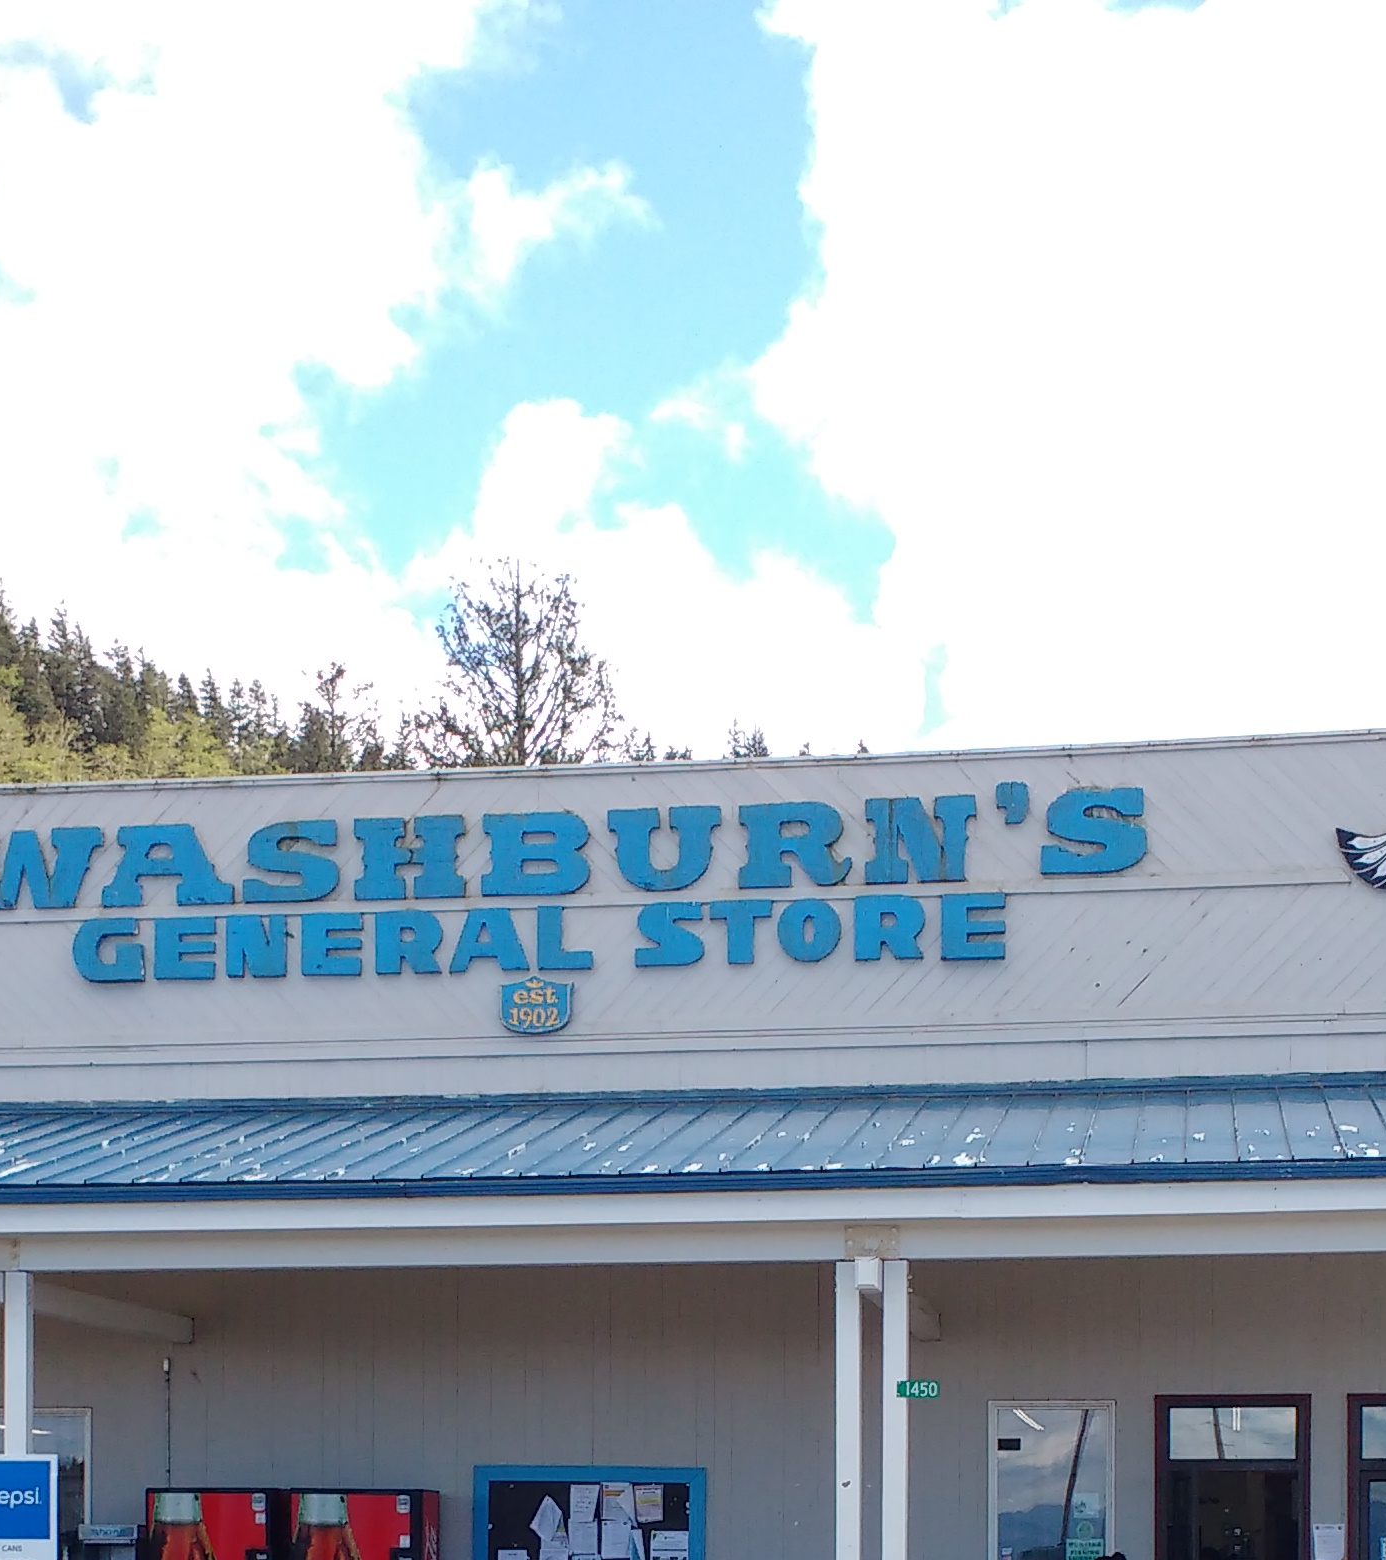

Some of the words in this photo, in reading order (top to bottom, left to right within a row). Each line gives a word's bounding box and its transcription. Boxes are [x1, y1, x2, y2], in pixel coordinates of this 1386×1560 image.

[72, 906, 594, 984] GENERAL
[634, 891, 1008, 968] STORE
[508, 1006, 561, 1028] 1902
[906, 1382, 938, 1396] 1450
